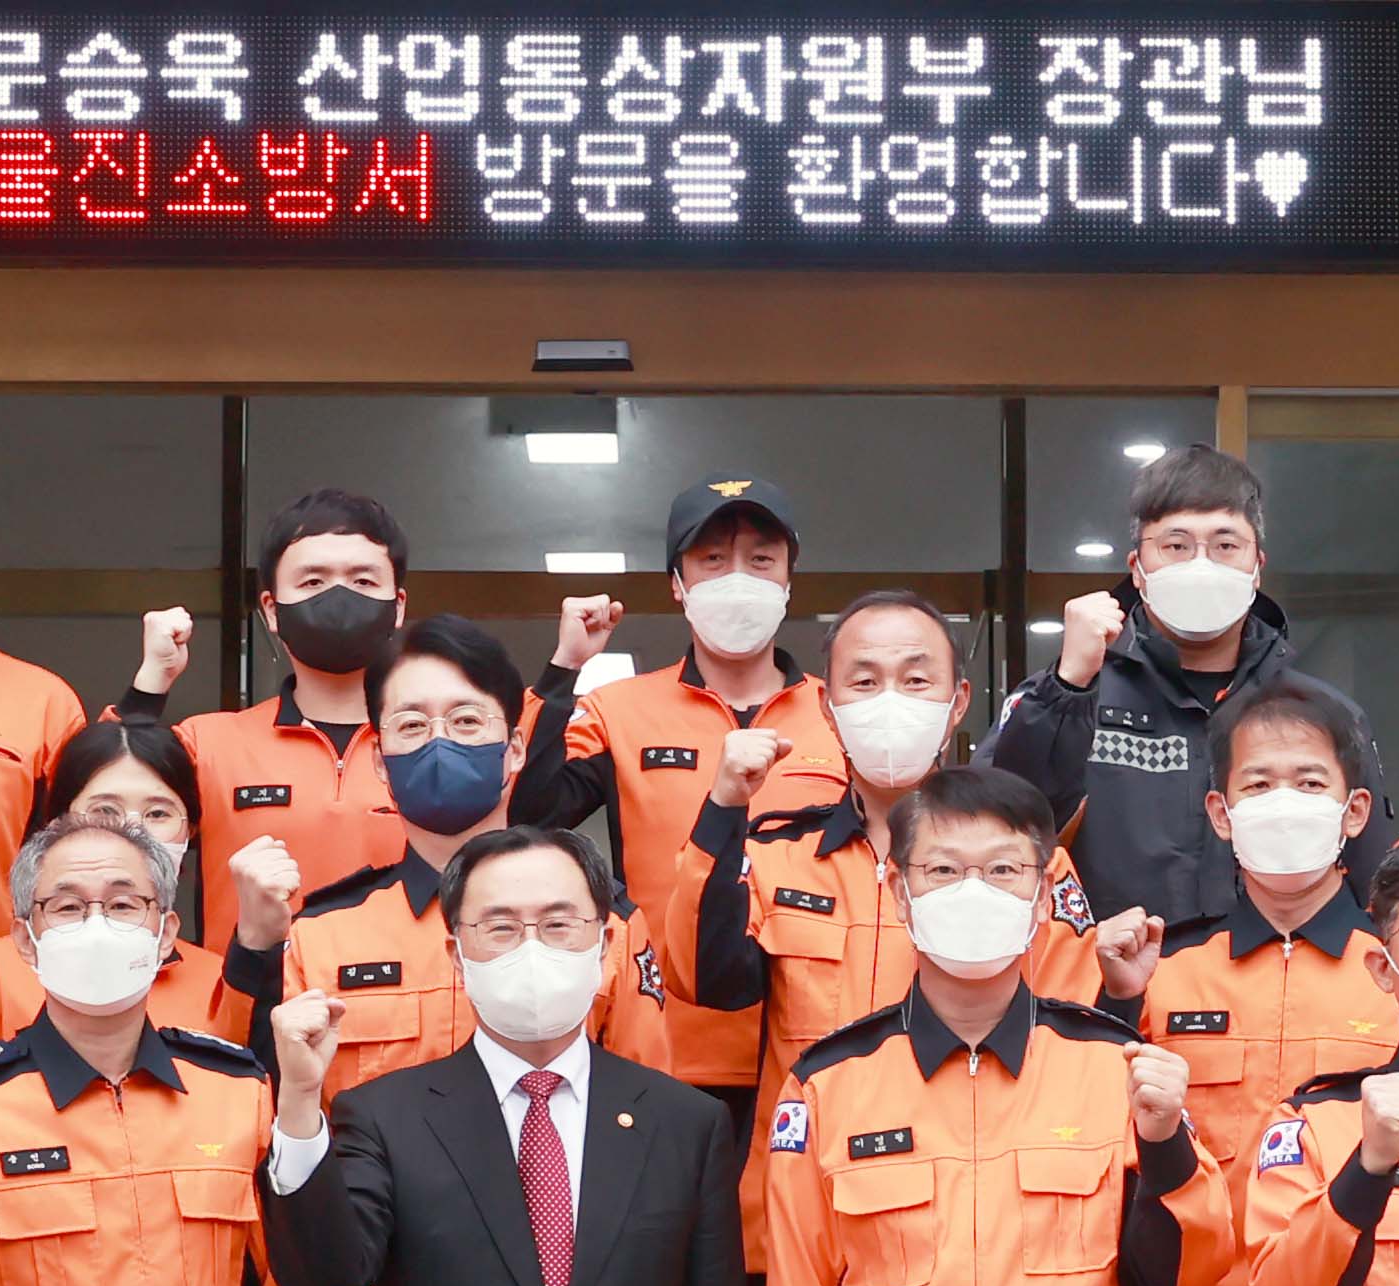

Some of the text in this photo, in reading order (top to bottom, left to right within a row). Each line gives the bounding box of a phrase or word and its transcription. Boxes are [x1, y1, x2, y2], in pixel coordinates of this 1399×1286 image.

[297, 34, 992, 124] 산업통상자원부
[1038, 36, 1324, 126] 장관님
[475, 133, 746, 223] 방문을
[786, 134, 1248, 224] 환영합니다
